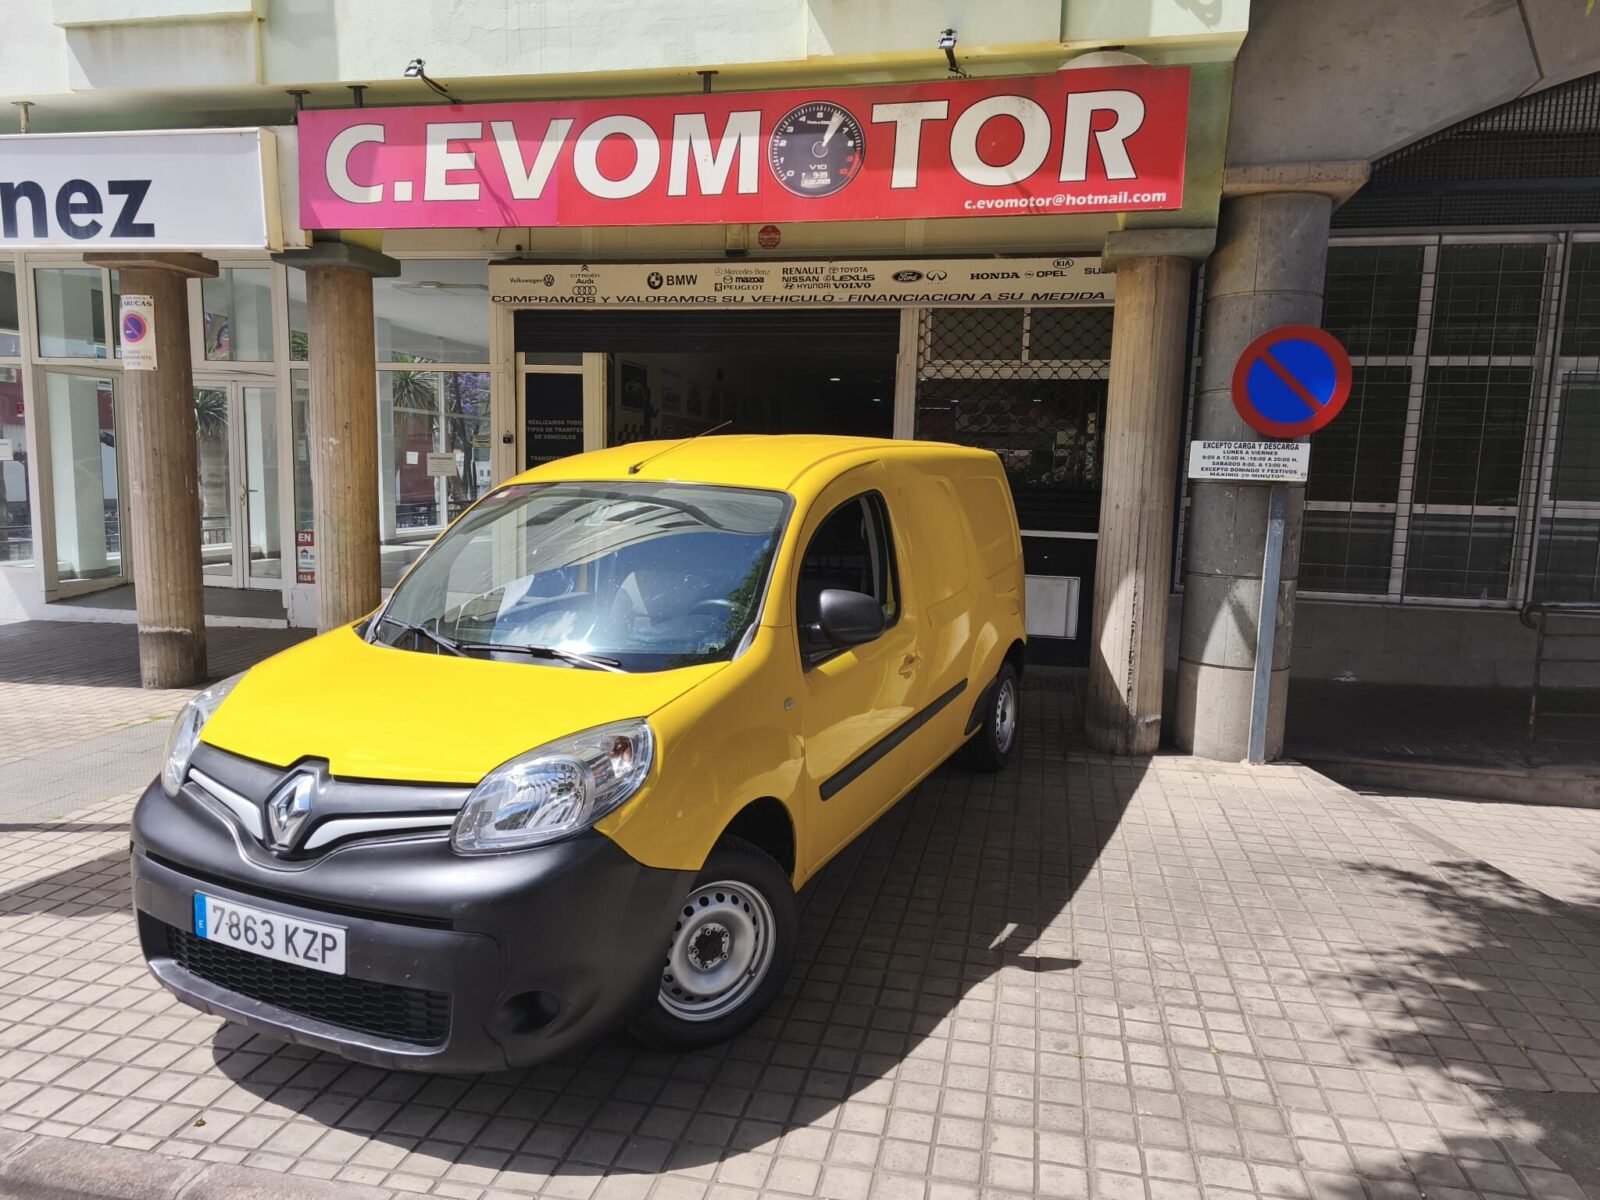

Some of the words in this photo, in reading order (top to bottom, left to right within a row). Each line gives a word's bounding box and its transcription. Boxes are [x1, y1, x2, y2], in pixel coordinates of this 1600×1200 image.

[964, 191, 1166, 209] c.evomotor@hotmail.com
[0, 178, 155, 240] nez
[782, 267, 825, 275] RENAULT
[970, 272, 1020, 280] HONDA
[666, 275, 697, 286] BMW
[848, 293, 975, 302] FINANCIACION
[978, 293, 992, 301] A
[1031, 292, 1105, 300] MEDIDA
[1234, 442, 1256, 450] CARGA
[198, 920, 204, 928] E
[212, 905, 274, 950] 7863
[284, 924, 337, 964] KZP
